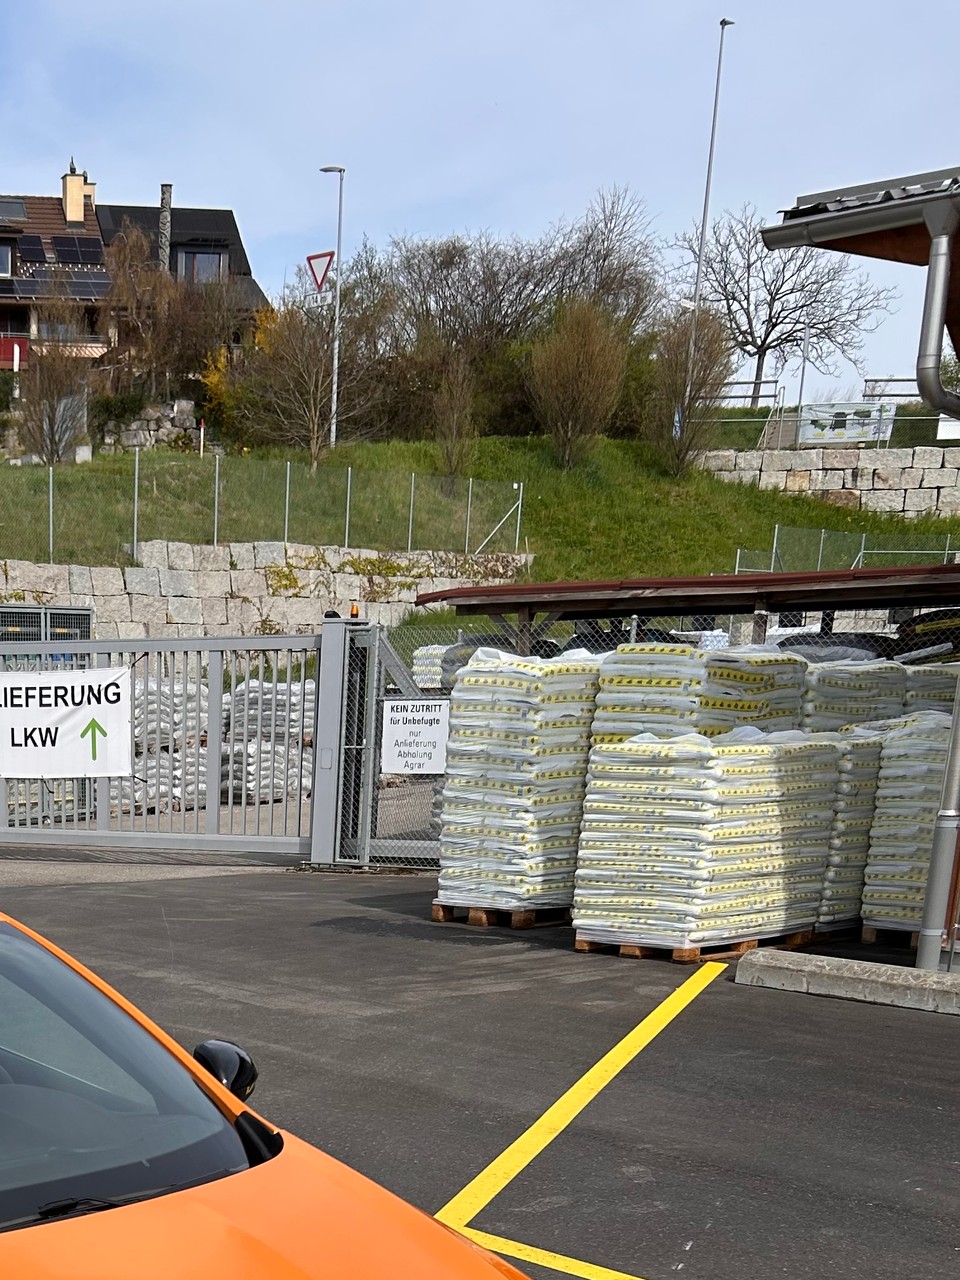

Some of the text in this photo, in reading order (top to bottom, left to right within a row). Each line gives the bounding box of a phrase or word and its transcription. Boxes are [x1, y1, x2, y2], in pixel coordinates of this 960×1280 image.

[390, 704, 442, 713] KEIN ZUTRITT
[390, 716, 440, 726] für Unbefugte
[10, 726, 59, 748] LKW
[394, 739, 436, 749] Anlieferung
[397, 750, 433, 760] Abholung
[403, 760, 425, 770] Agrar
